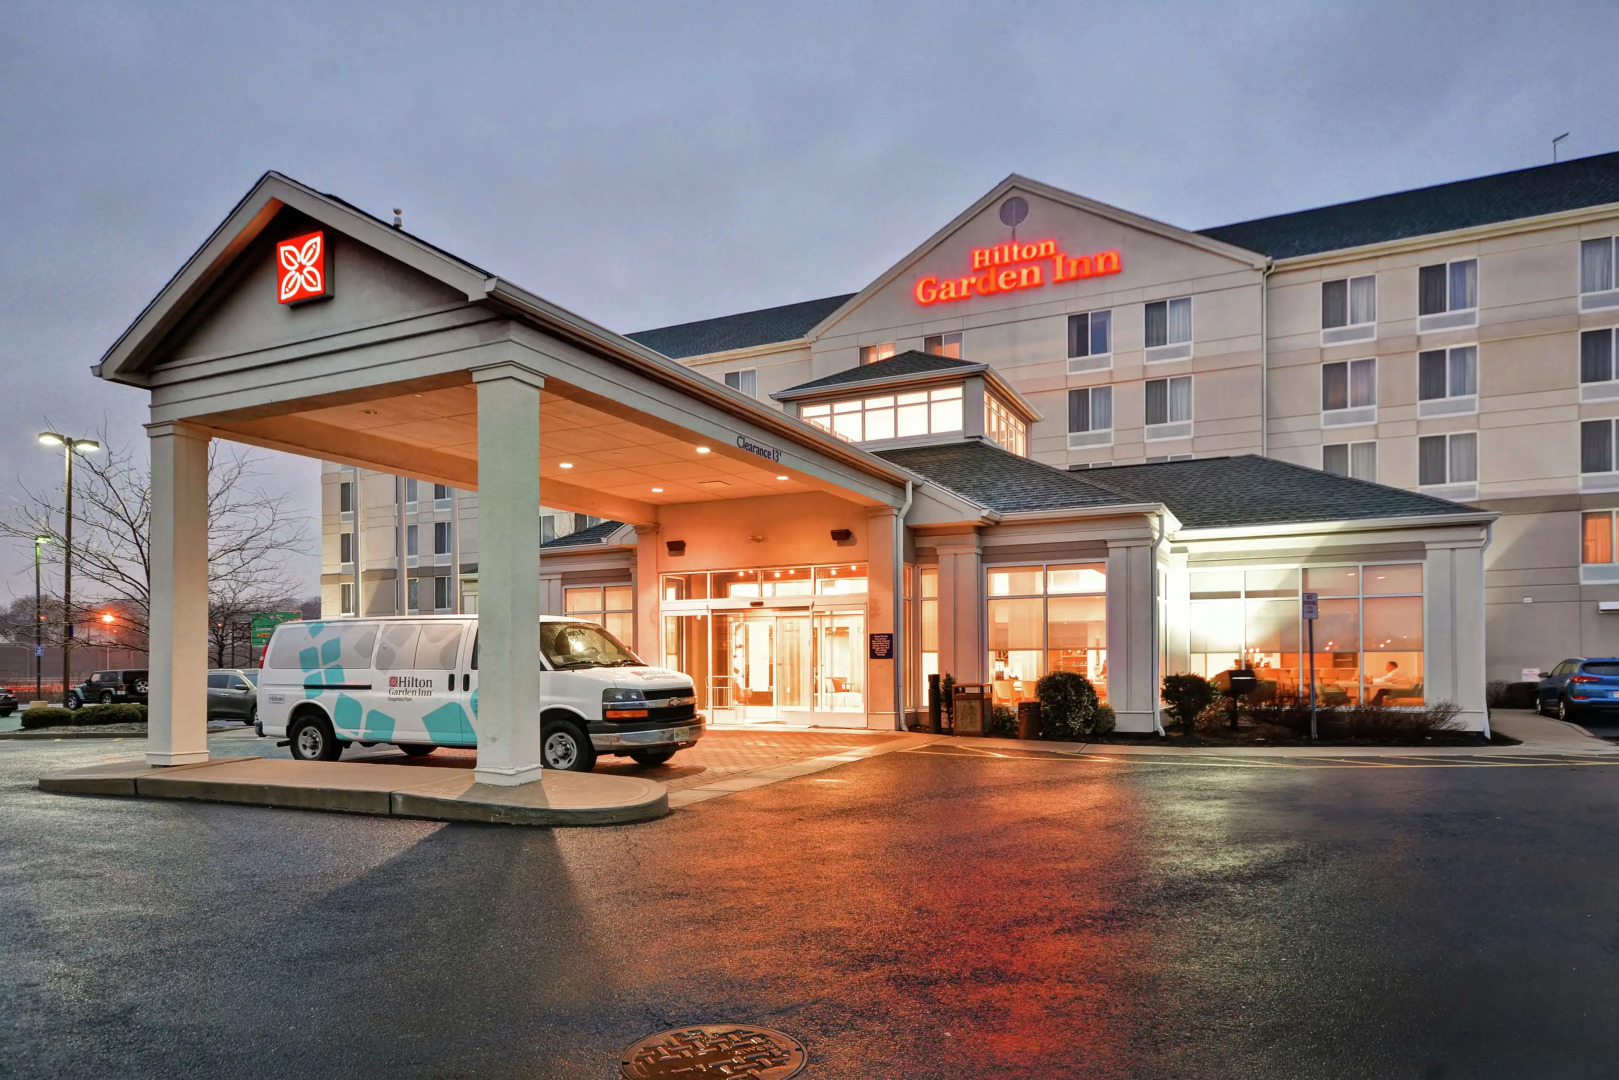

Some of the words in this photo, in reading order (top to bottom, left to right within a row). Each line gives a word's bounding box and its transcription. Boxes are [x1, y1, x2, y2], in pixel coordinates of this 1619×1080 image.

[972, 239, 1056, 269] Hilton
[915, 266, 1043, 304] Garden
[1053, 250, 1121, 282] Inn
[736, 435, 771, 460] Clearance
[388, 688, 416, 696] Garden
[418, 688, 432, 697] Inn
[398, 676, 433, 688] Hilton
